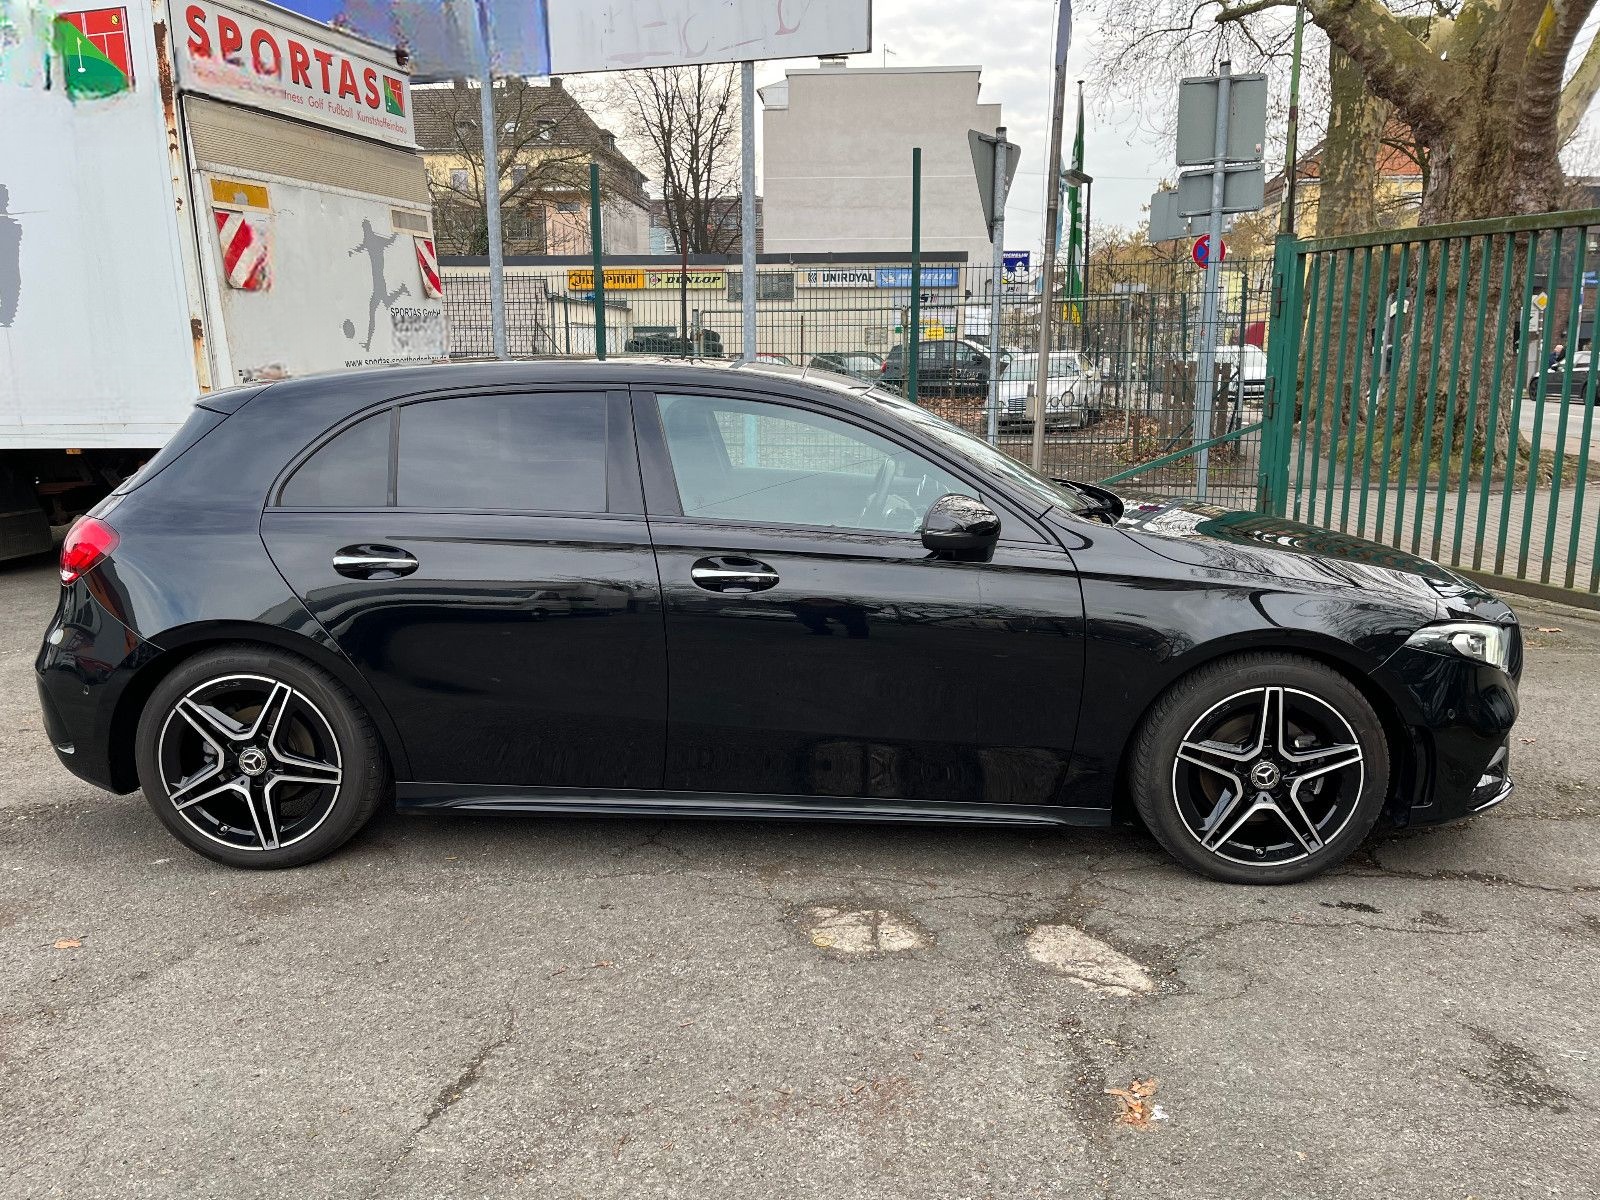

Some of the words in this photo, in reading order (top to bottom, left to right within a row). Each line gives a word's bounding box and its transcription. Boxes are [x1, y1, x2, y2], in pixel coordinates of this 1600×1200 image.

[185, 4, 380, 110] SPORTAS
[308, 95, 325, 110] Golf
[327, 101, 354, 120] Fußball
[665, 276, 721, 284] DUNLOP
[822, 272, 875, 283] UNIROYAL
[897, 273, 953, 281] MIHELIN
[390, 307, 422, 317] SPORTAS
[422, 307, 441, 317] GmbH
